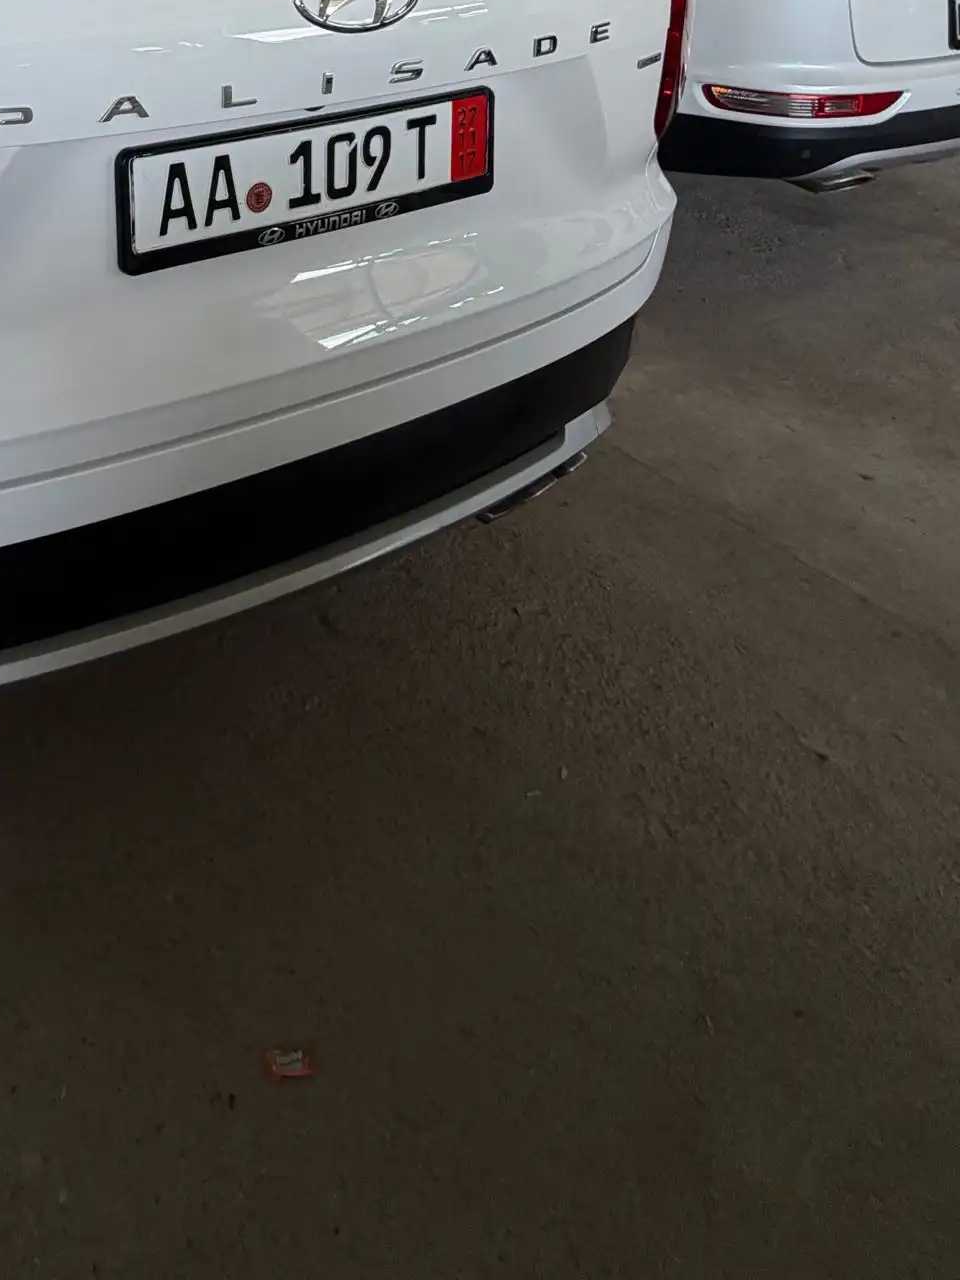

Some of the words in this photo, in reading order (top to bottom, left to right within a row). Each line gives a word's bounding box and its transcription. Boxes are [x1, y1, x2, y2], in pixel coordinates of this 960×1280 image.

[159, 154, 241, 236] AA
[288, 126, 391, 208] 109
[407, 114, 437, 180] T
[295, 210, 367, 238] HYUNDAI
